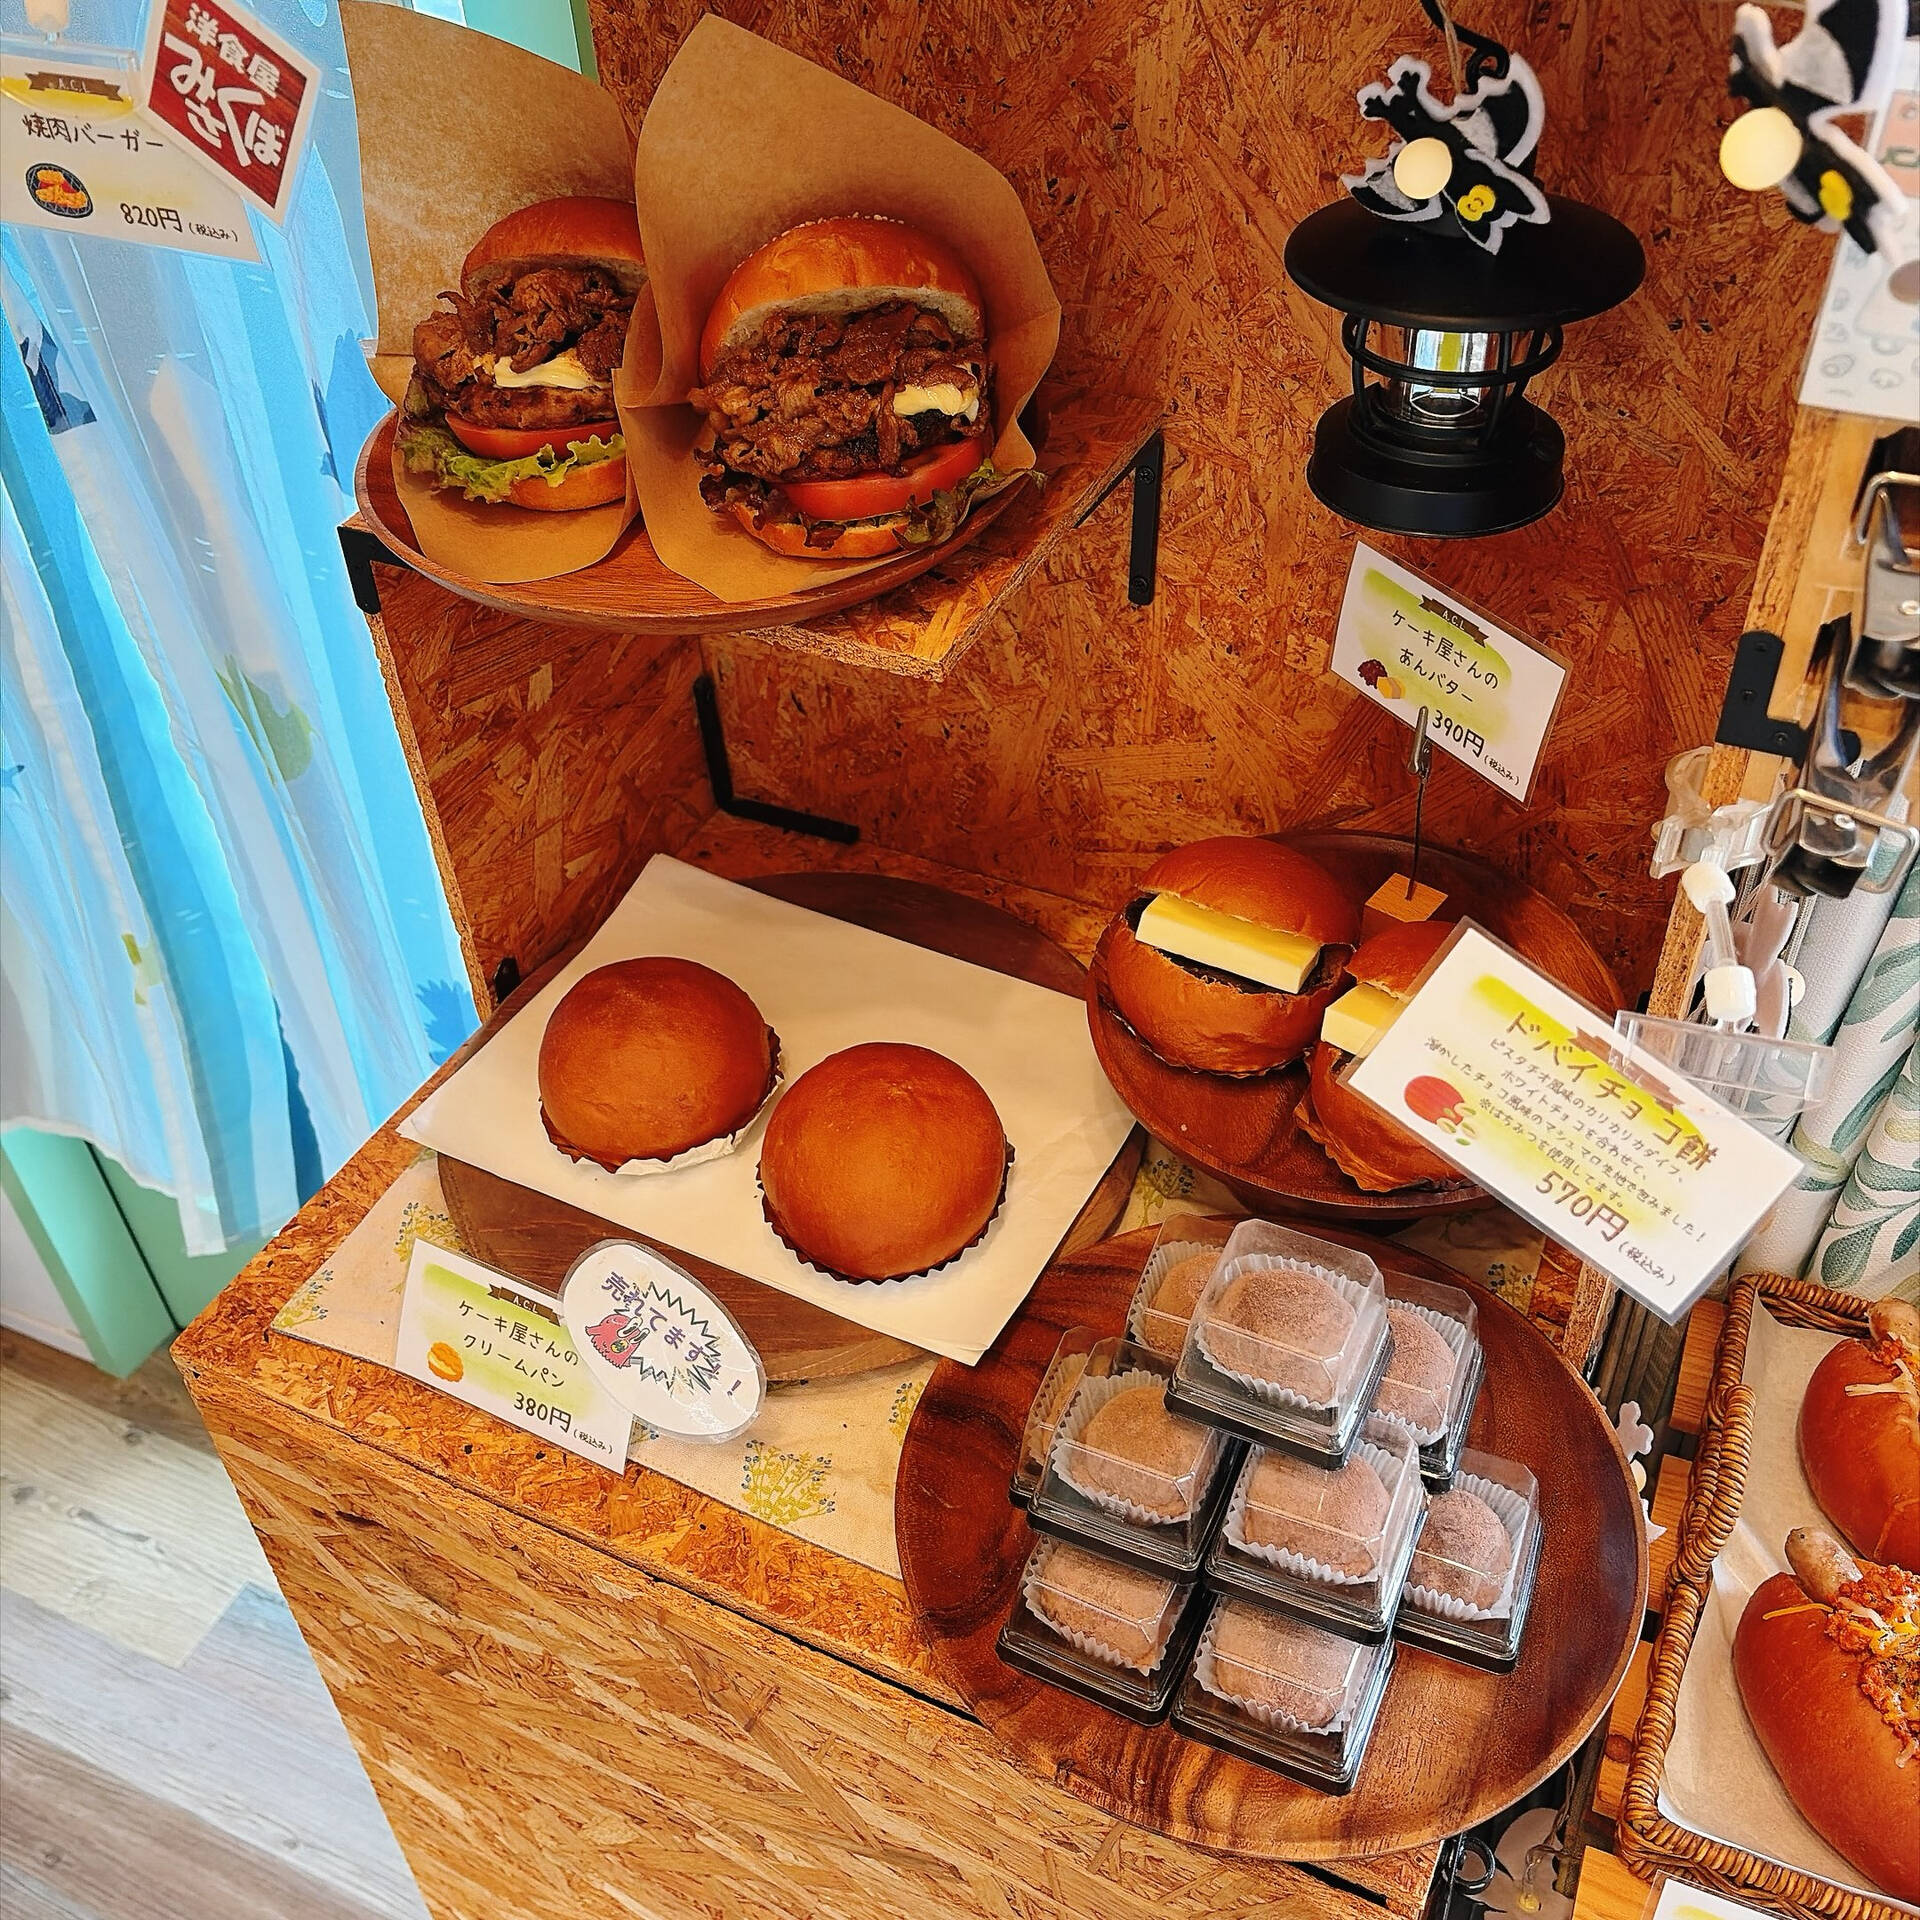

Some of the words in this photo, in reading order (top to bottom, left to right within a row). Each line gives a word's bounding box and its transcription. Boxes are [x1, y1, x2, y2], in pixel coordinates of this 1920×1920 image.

[184, 3, 281, 98] 洋食屋
[21, 113, 163, 152] 焼肉バーガー
[120, 203, 183, 233] 820円
[1391, 609, 1499, 690] ケーキ屋さんの
[1399, 647, 1474, 703] あんバター
[1431, 709, 1485, 758] 390円
[1489, 1038, 1684, 1183] ピスタチオ風味のカリカリカダイフ、
[1500, 1069, 1647, 1181] ホワイトチョコを合わせて、
[1505, 1009, 1719, 1172] ドバイチョコ餅
[1479, 1097, 1624, 1209] ※はちみつを使用してます。
[1535, 1169, 1630, 1242] 570円
[458, 1299, 580, 1368] ケーキ屋さんの
[462, 1334, 566, 1389] クリームパン
[513, 1391, 572, 1435] 380円
